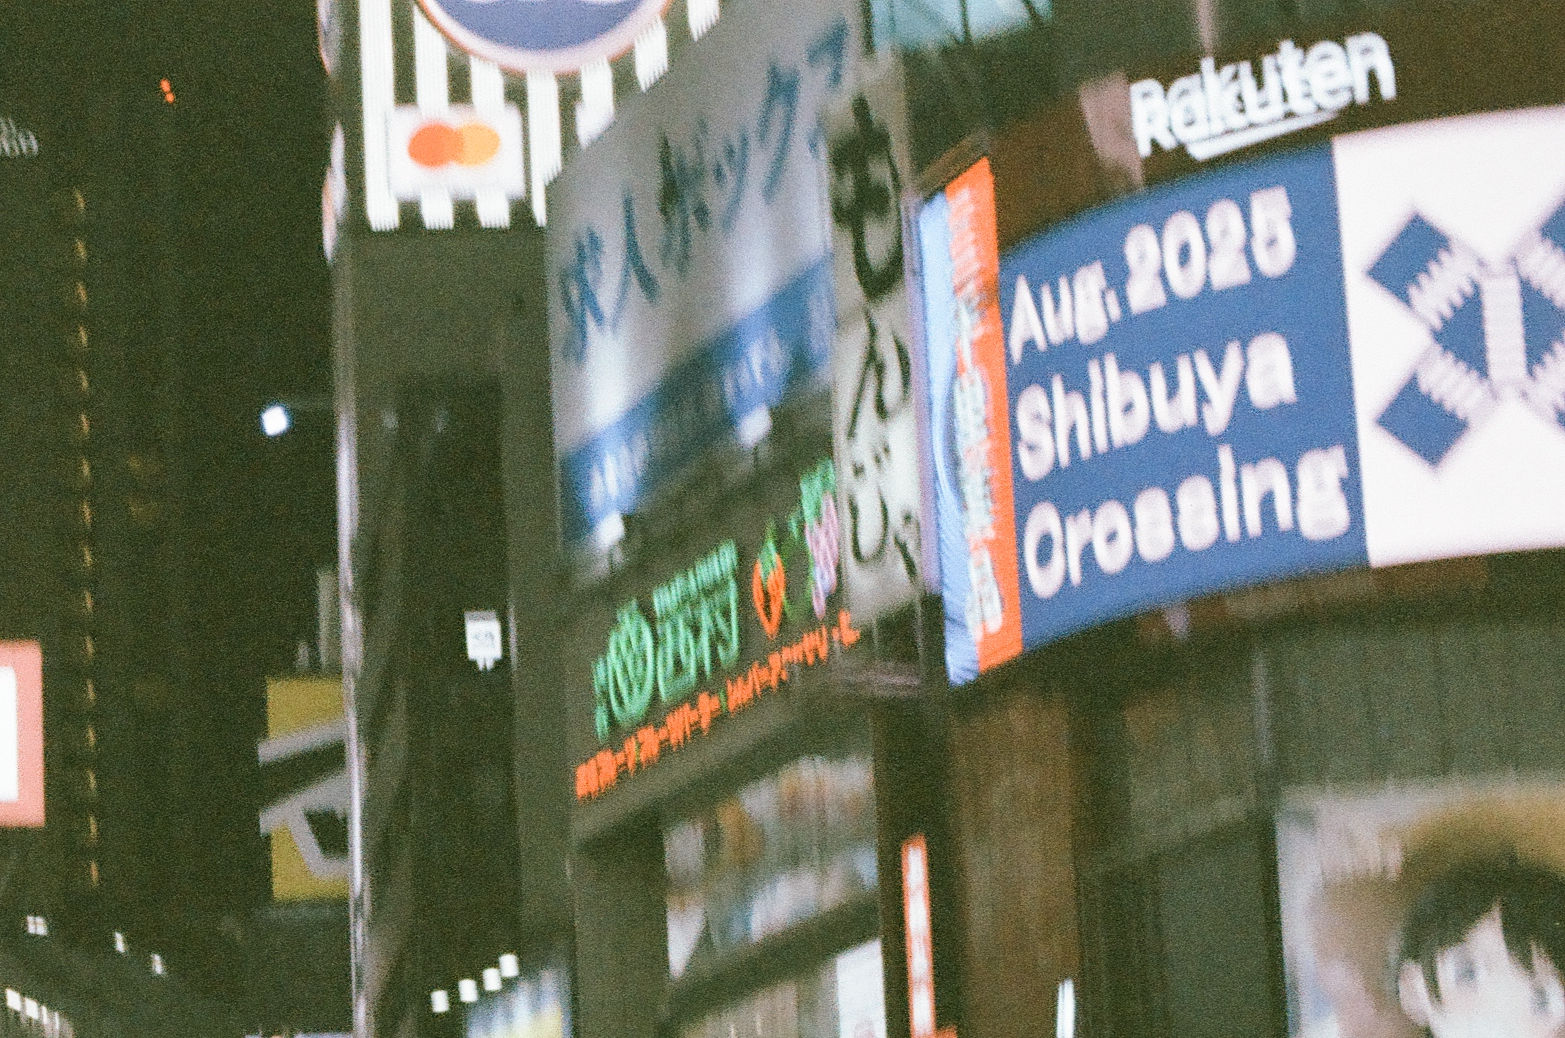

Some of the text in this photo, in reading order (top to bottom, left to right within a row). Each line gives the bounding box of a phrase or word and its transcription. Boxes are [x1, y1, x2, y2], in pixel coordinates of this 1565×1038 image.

[1130, 31, 1397, 158] Rakuten
[1008, 186, 1298, 365] Aug. 2025
[1015, 330, 1298, 482] Shibuya
[1023, 442, 1352, 599] Crossing
